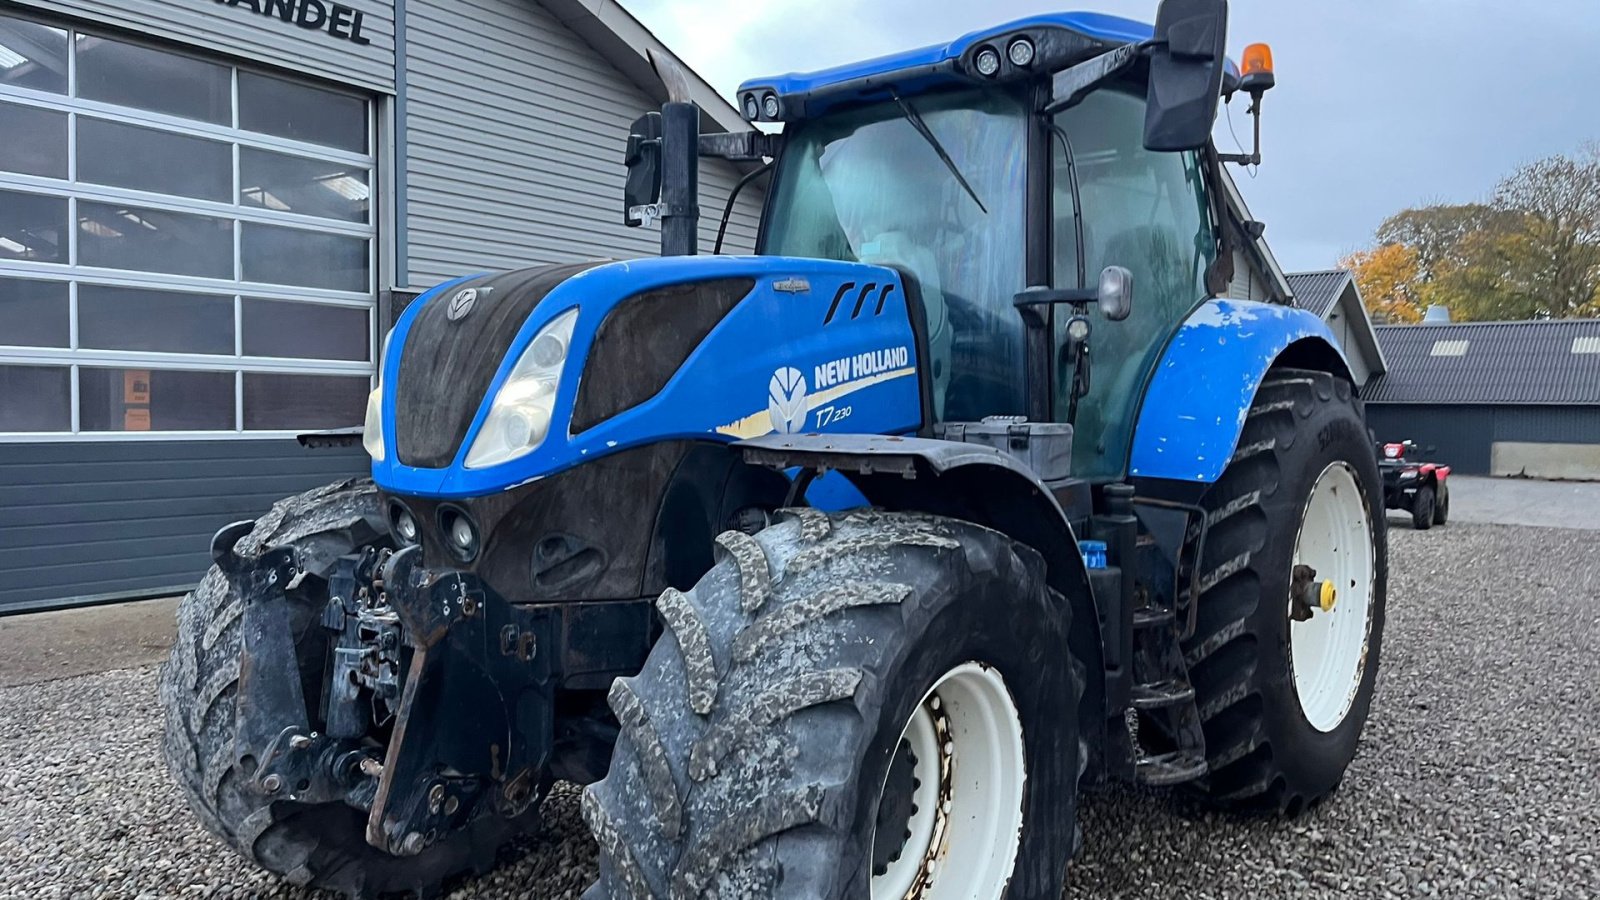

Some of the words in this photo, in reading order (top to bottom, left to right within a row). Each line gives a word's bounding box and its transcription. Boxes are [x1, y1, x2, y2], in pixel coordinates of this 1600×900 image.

[216, 0, 370, 45] NDEL
[816, 357, 850, 389] NEW
[853, 346, 908, 377] HOLLAND
